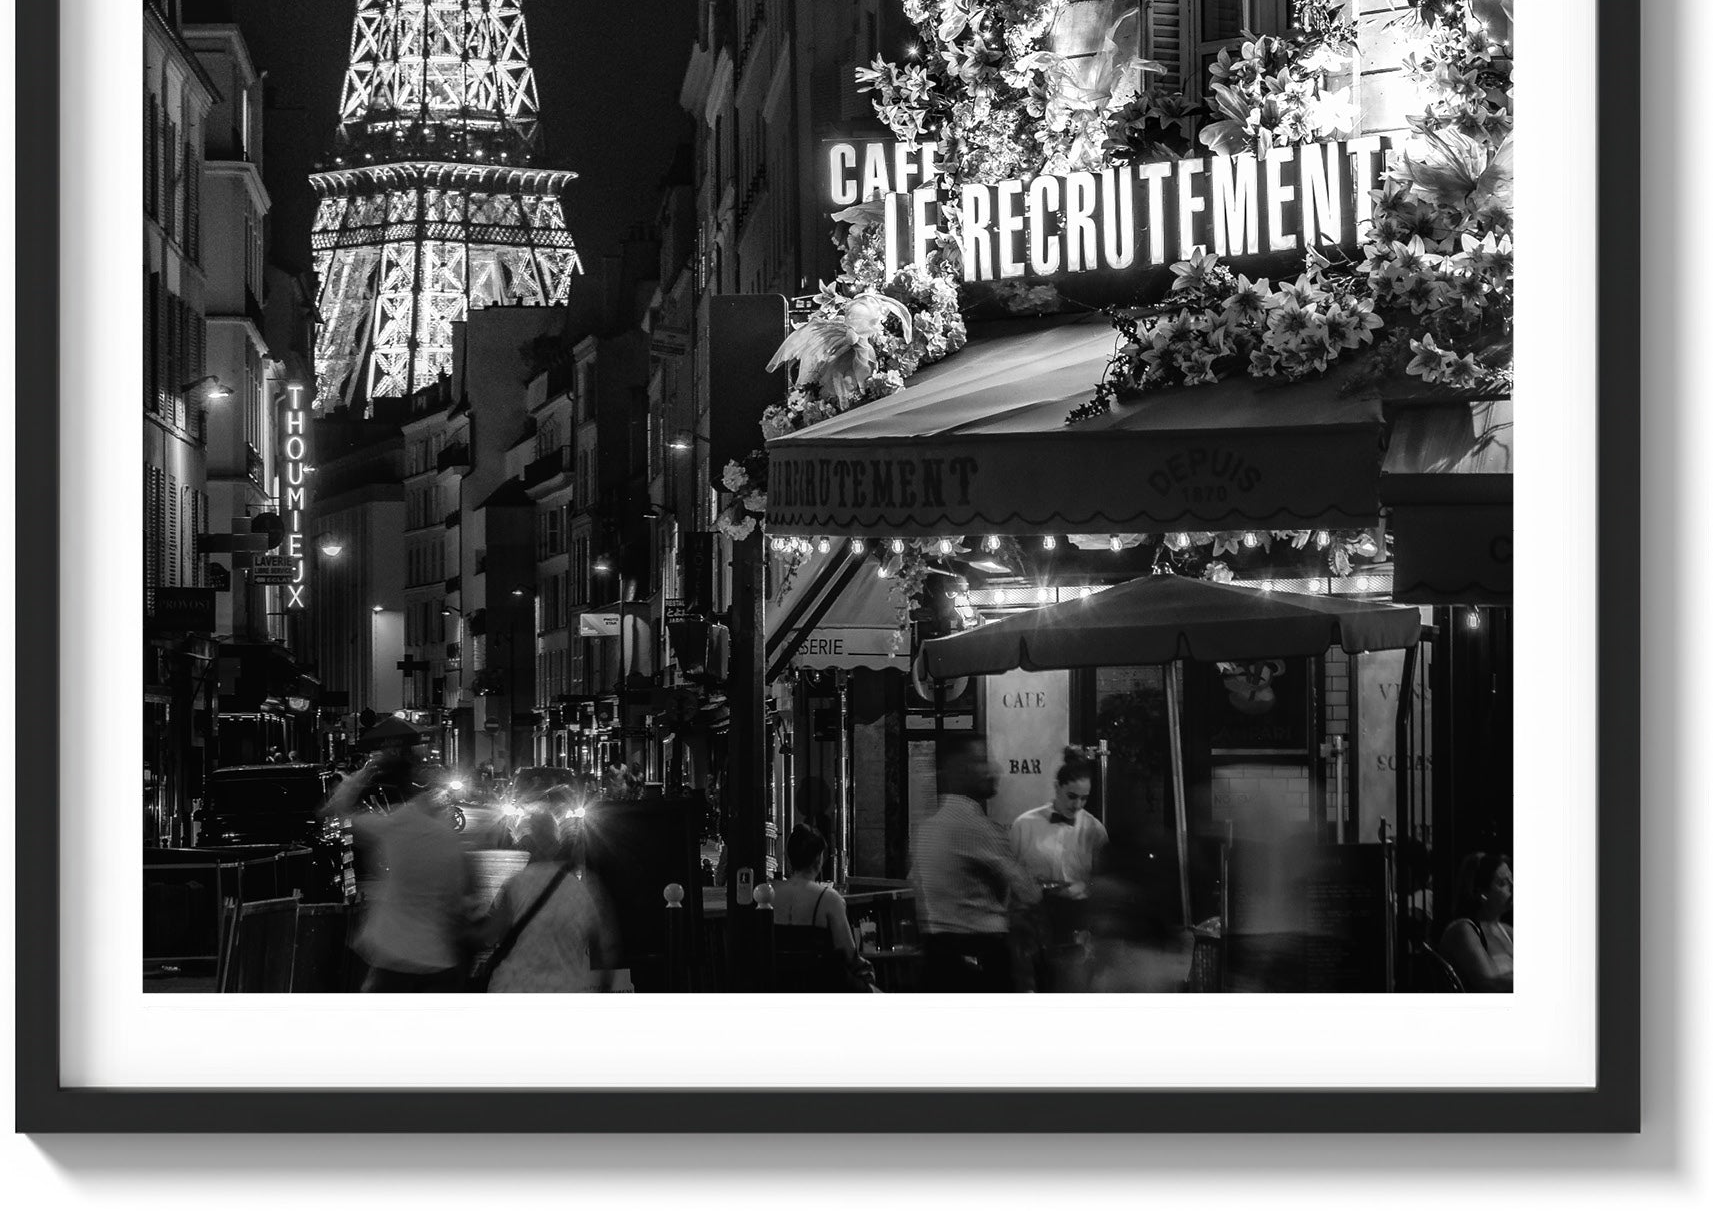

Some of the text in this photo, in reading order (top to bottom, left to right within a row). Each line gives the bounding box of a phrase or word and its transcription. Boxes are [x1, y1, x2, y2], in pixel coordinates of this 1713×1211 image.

[962, 136, 1381, 282] RECRUTEMENT
[784, 456, 979, 508] RECRUTEMENT
[1148, 447, 1263, 497] DEPUIS
[254, 556, 293, 566] LAVERIE
[1009, 758, 1041, 774] BAR
